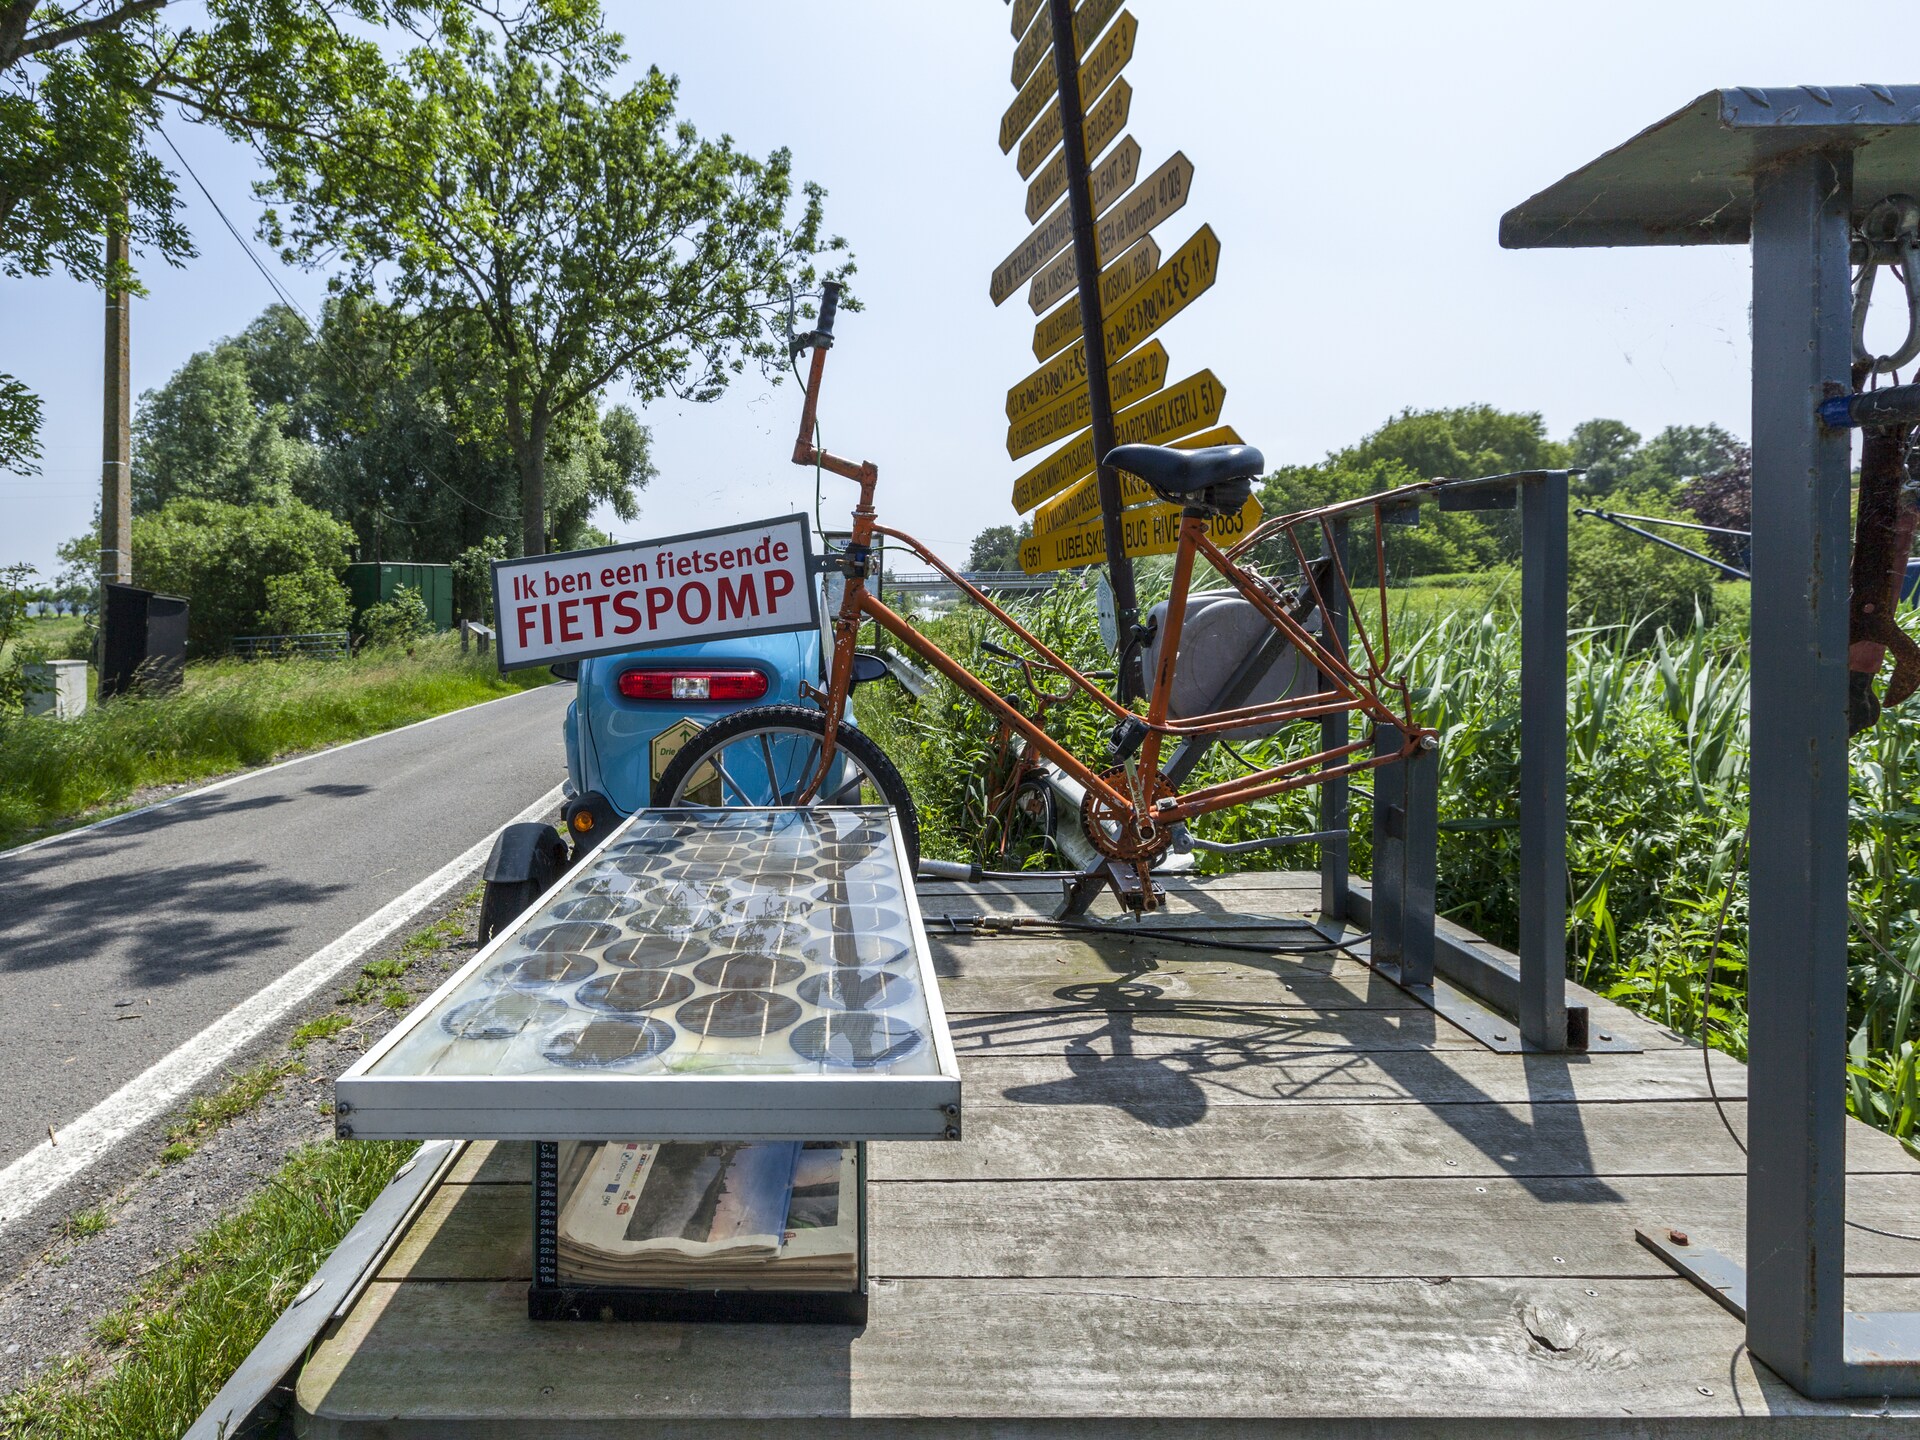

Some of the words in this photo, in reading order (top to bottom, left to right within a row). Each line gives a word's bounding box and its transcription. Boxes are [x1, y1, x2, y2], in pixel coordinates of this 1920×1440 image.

[1083, 32, 1119, 99] DIKSMUIDE
[1121, 23, 1127, 52] 9
[1087, 98, 1114, 152] BRUGGE
[1103, 260, 1131, 308] MOSKOU
[1106, 331, 1116, 356] DE
[1115, 306, 1137, 346] DOLLE
[1136, 256, 1189, 332] BROUWERS
[1044, 345, 1087, 396] BROUWERS
[1149, 351, 1159, 381] 22
[1115, 388, 1198, 446] PAARDENMELKERIJ
[1023, 545, 1042, 568] 1561
[1126, 519, 1148, 549] BUG
[1154, 512, 1182, 545] RIVE
[513, 574, 538, 601] Ik
[545, 570, 592, 597] ben
[600, 563, 648, 588] een
[656, 537, 789, 579] fietsende
[516, 569, 795, 648] FIETSPOMP
[660, 748, 676, 756] Drie
